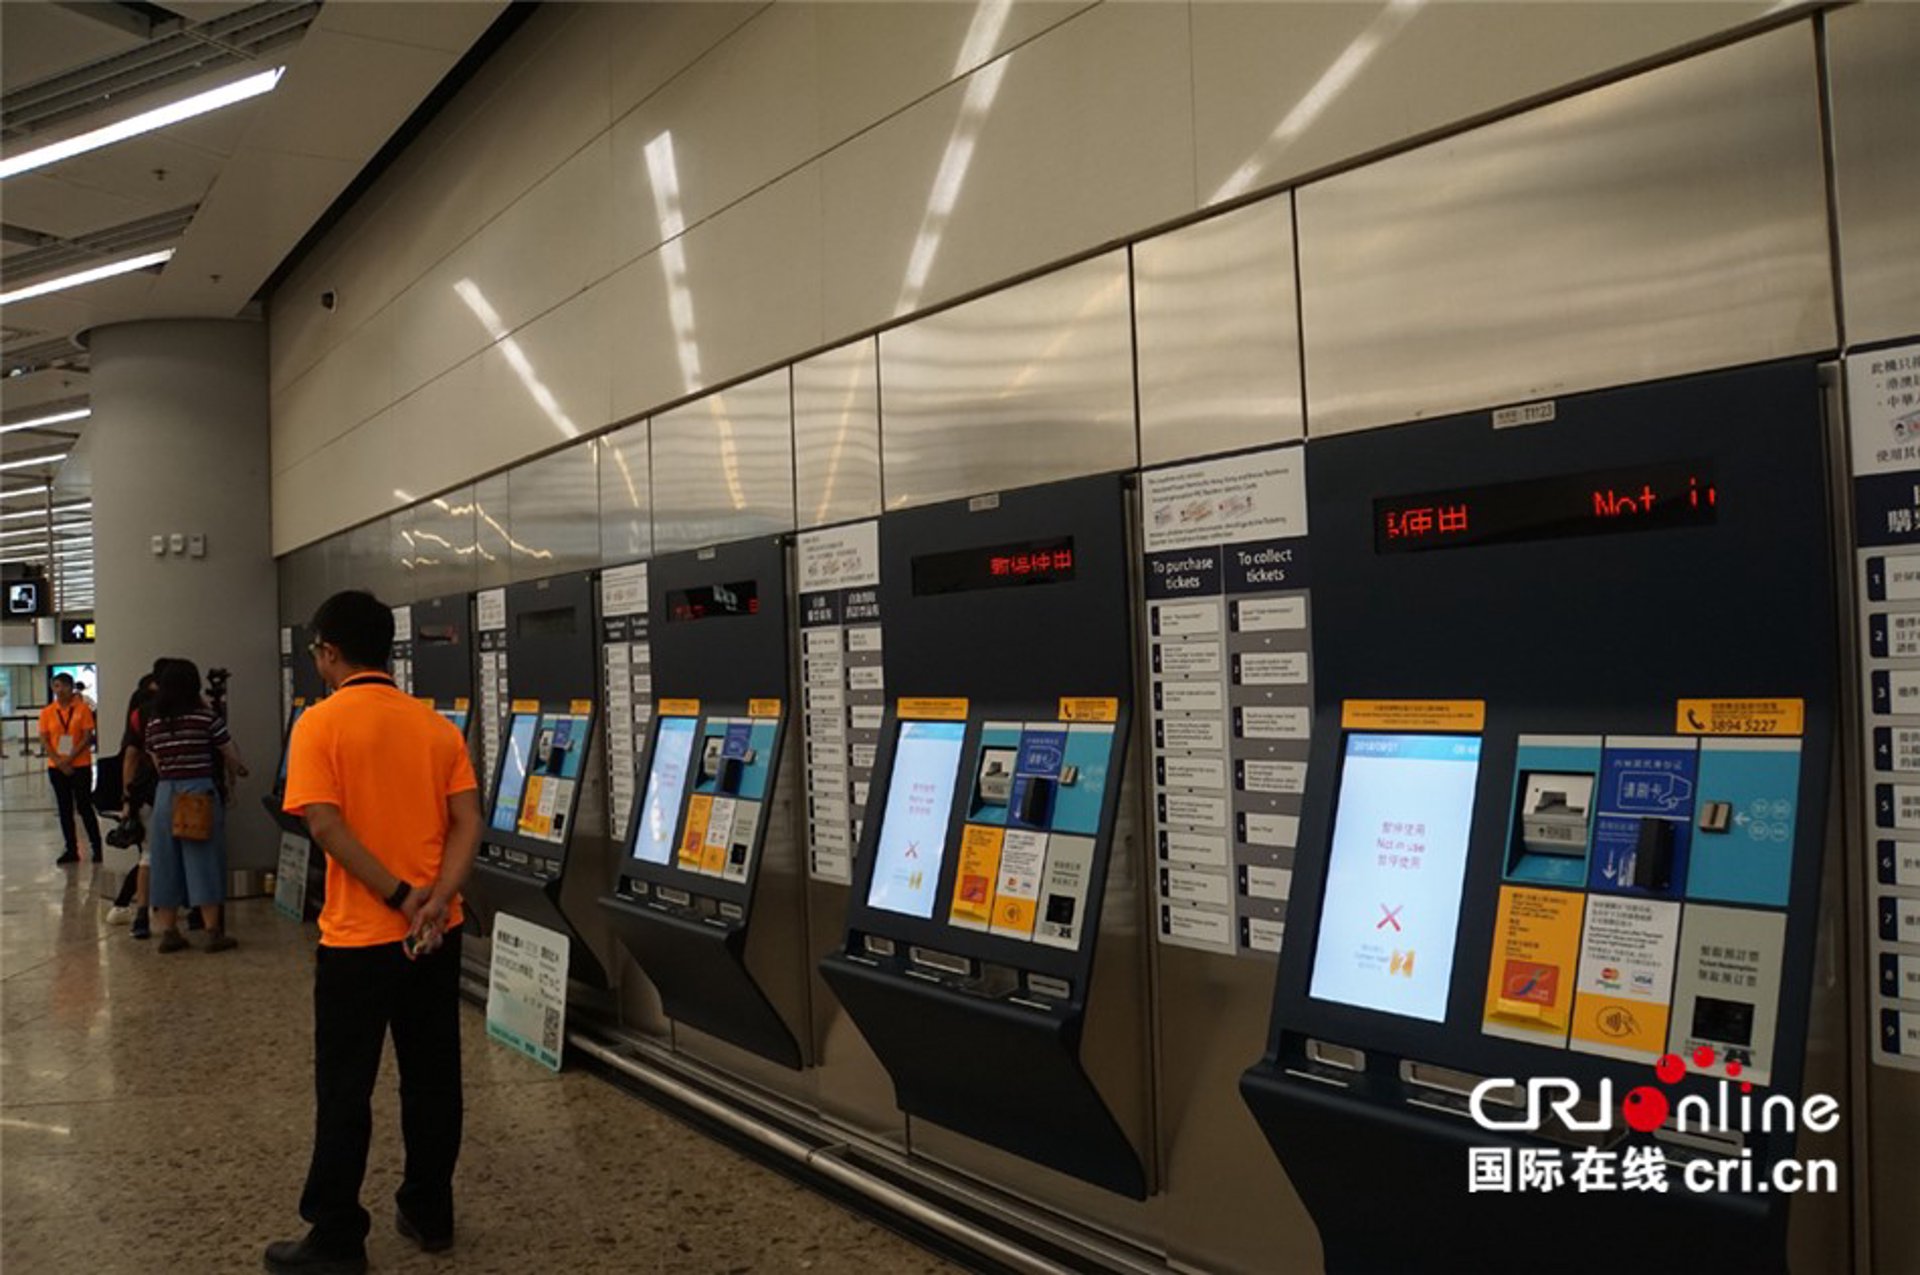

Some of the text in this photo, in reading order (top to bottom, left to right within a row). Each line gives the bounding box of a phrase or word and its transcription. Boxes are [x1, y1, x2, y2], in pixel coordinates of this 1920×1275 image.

[1593, 485, 1656, 516] Not
[1238, 548, 1293, 565] To collect
[1152, 556, 1214, 575] To purchase
[1166, 576, 1201, 590] tickets
[1246, 568, 1285, 583] tickets
[1711, 719, 1777, 733] 3894 5227
